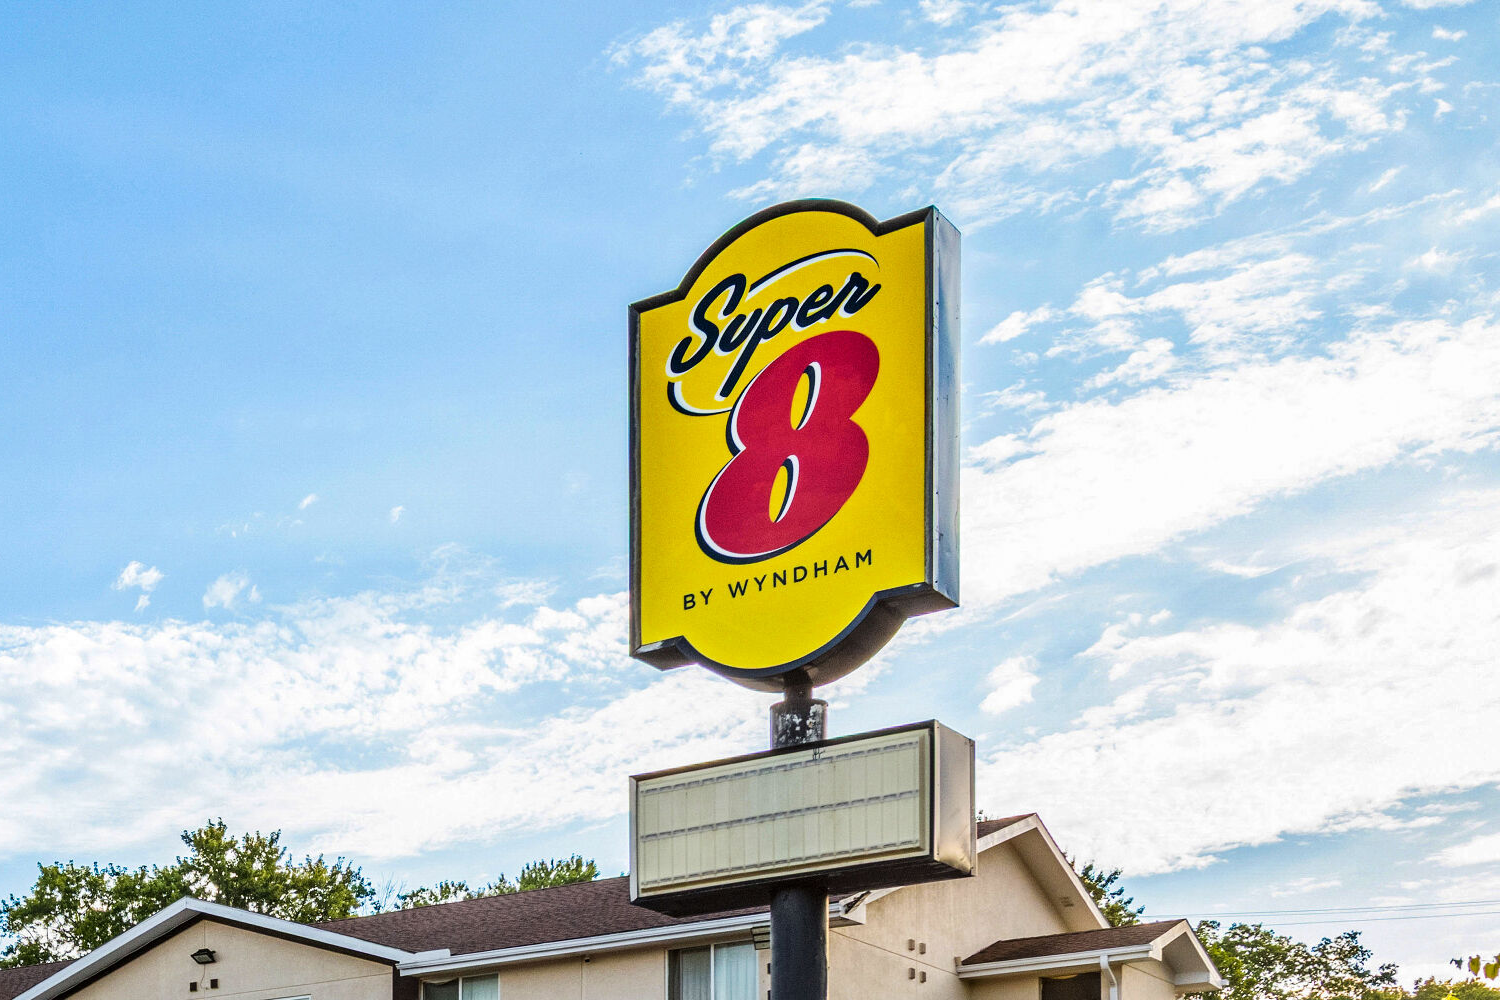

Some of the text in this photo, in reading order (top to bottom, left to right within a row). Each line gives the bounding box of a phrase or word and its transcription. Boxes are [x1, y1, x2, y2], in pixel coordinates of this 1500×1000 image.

[666, 271, 882, 402] Super
[695, 330, 880, 566] 8
[683, 549, 872, 611] BY WYNDHAM
